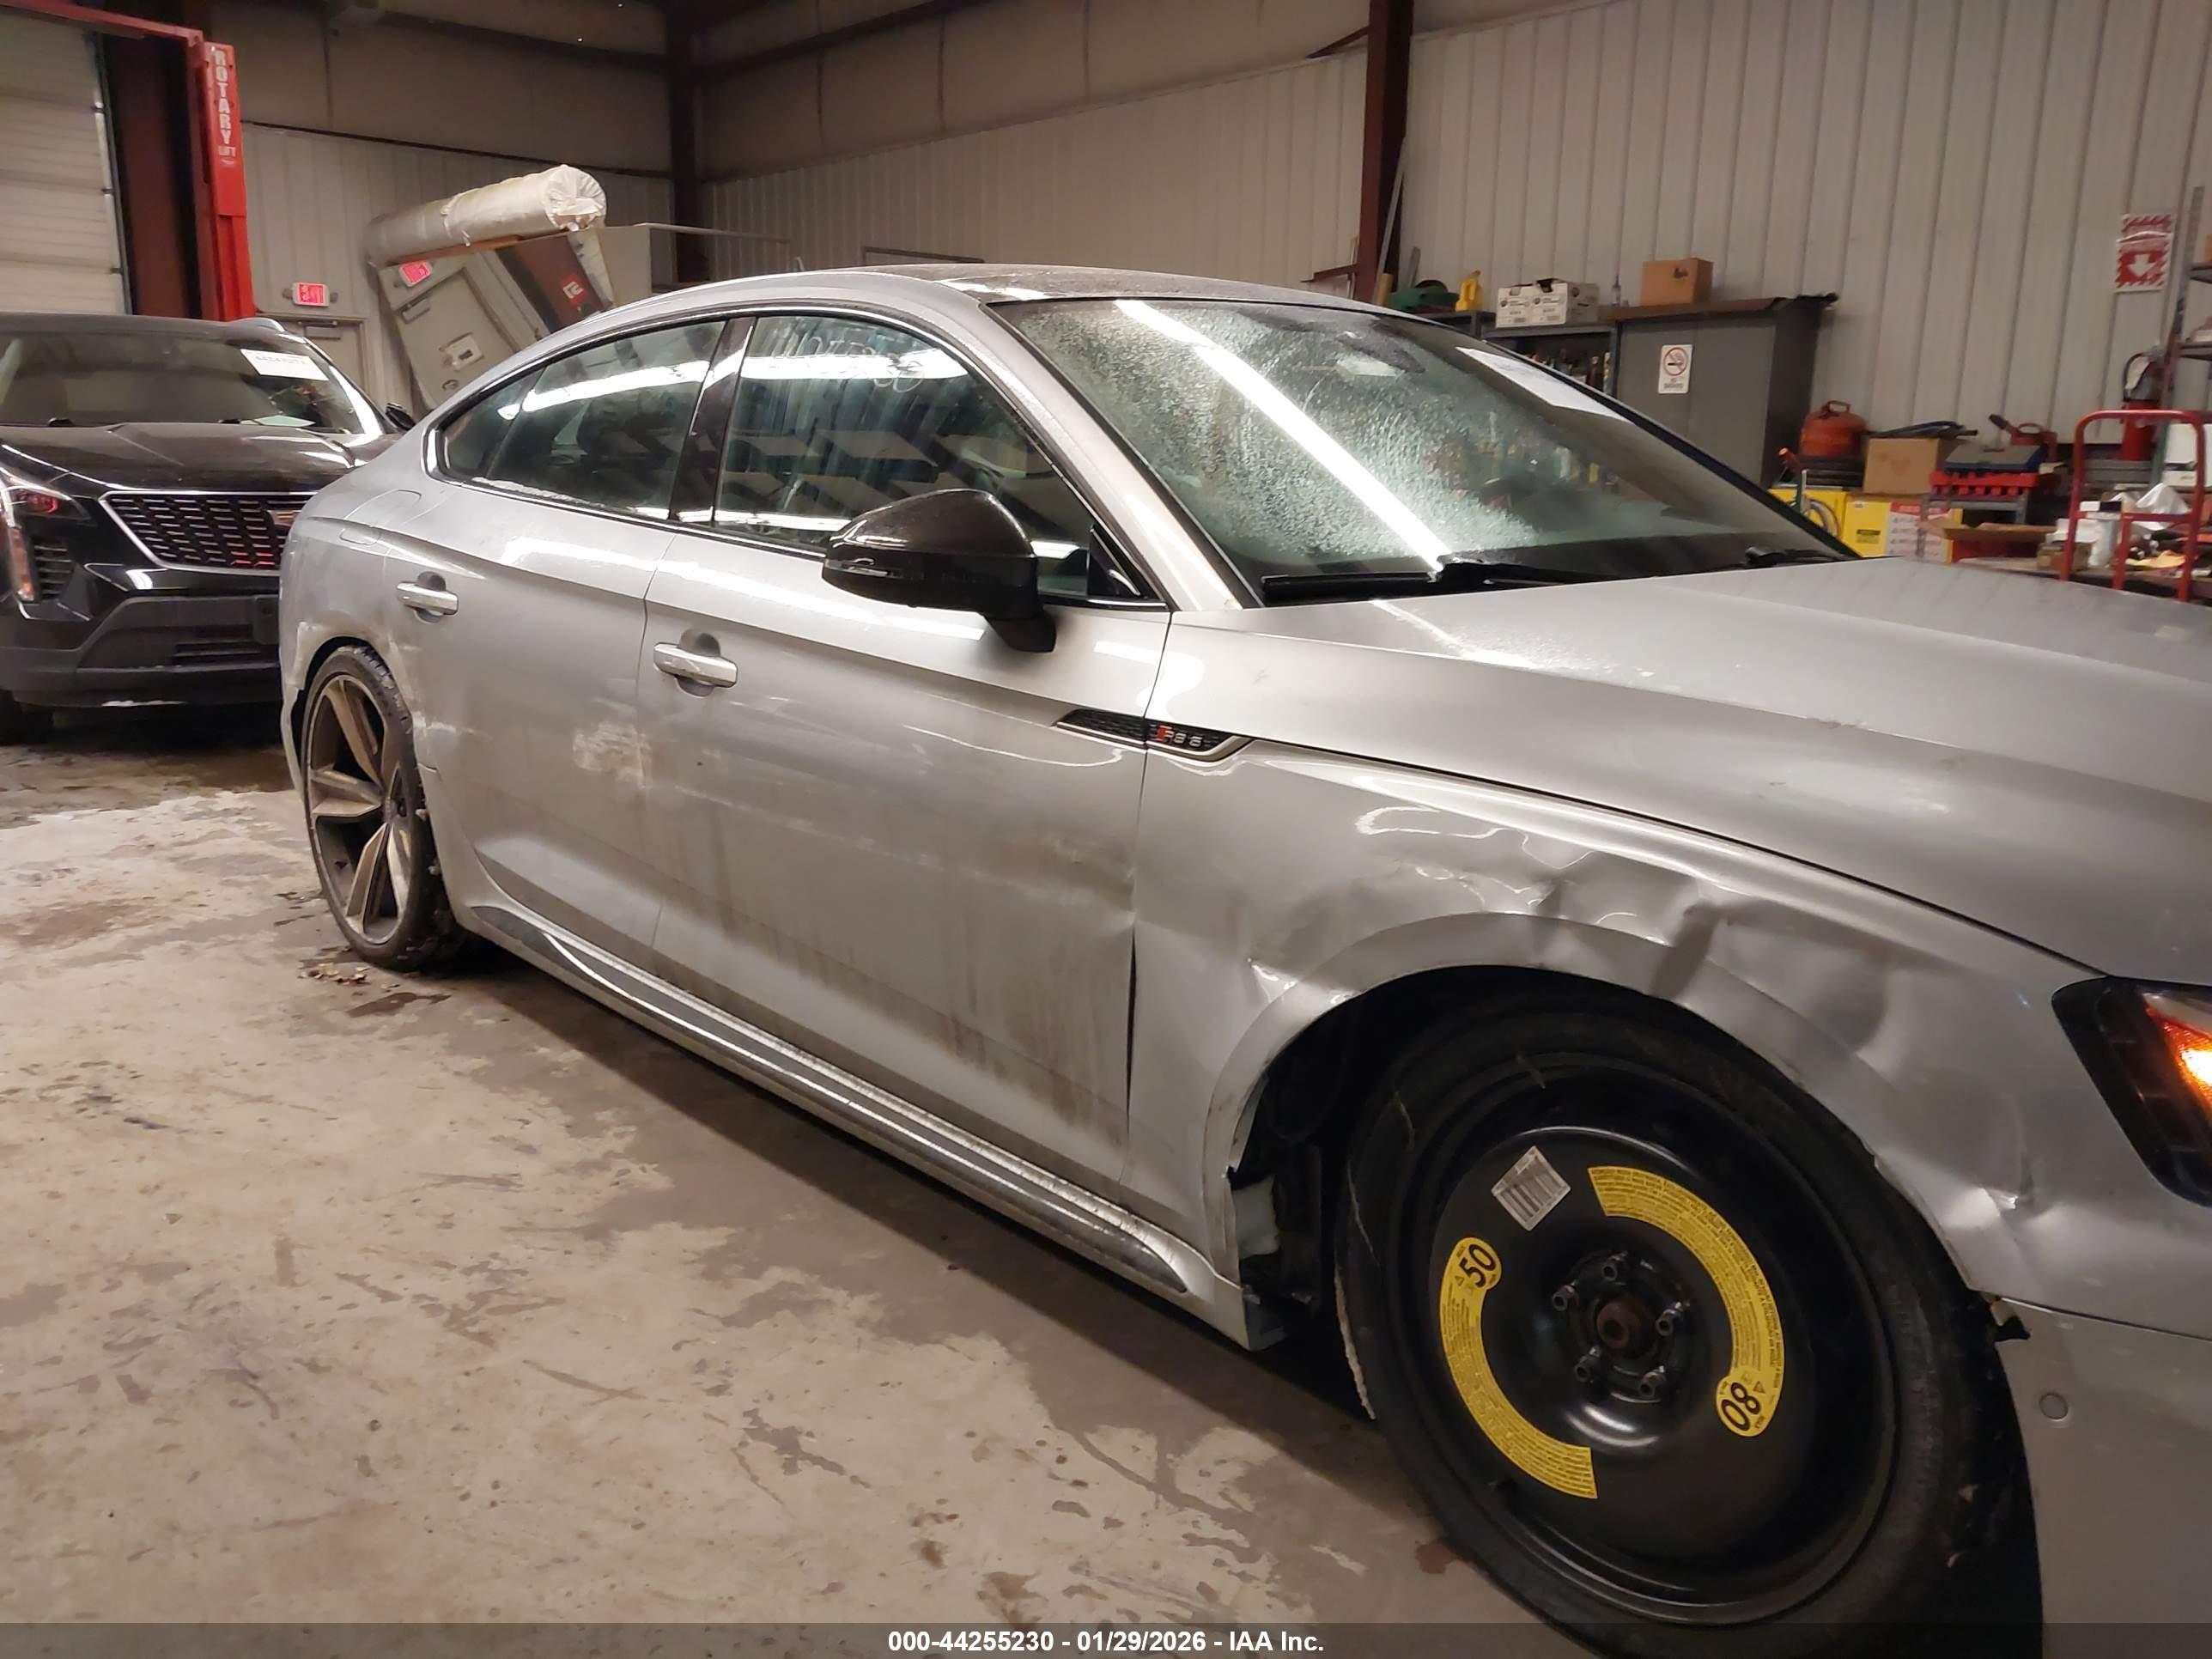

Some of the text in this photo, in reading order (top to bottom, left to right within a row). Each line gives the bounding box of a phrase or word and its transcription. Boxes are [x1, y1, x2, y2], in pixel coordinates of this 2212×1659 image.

[215, 50, 232, 144] ROTARY
[1460, 1243, 1497, 1289] 50
[1721, 1382, 1761, 1432] 80
